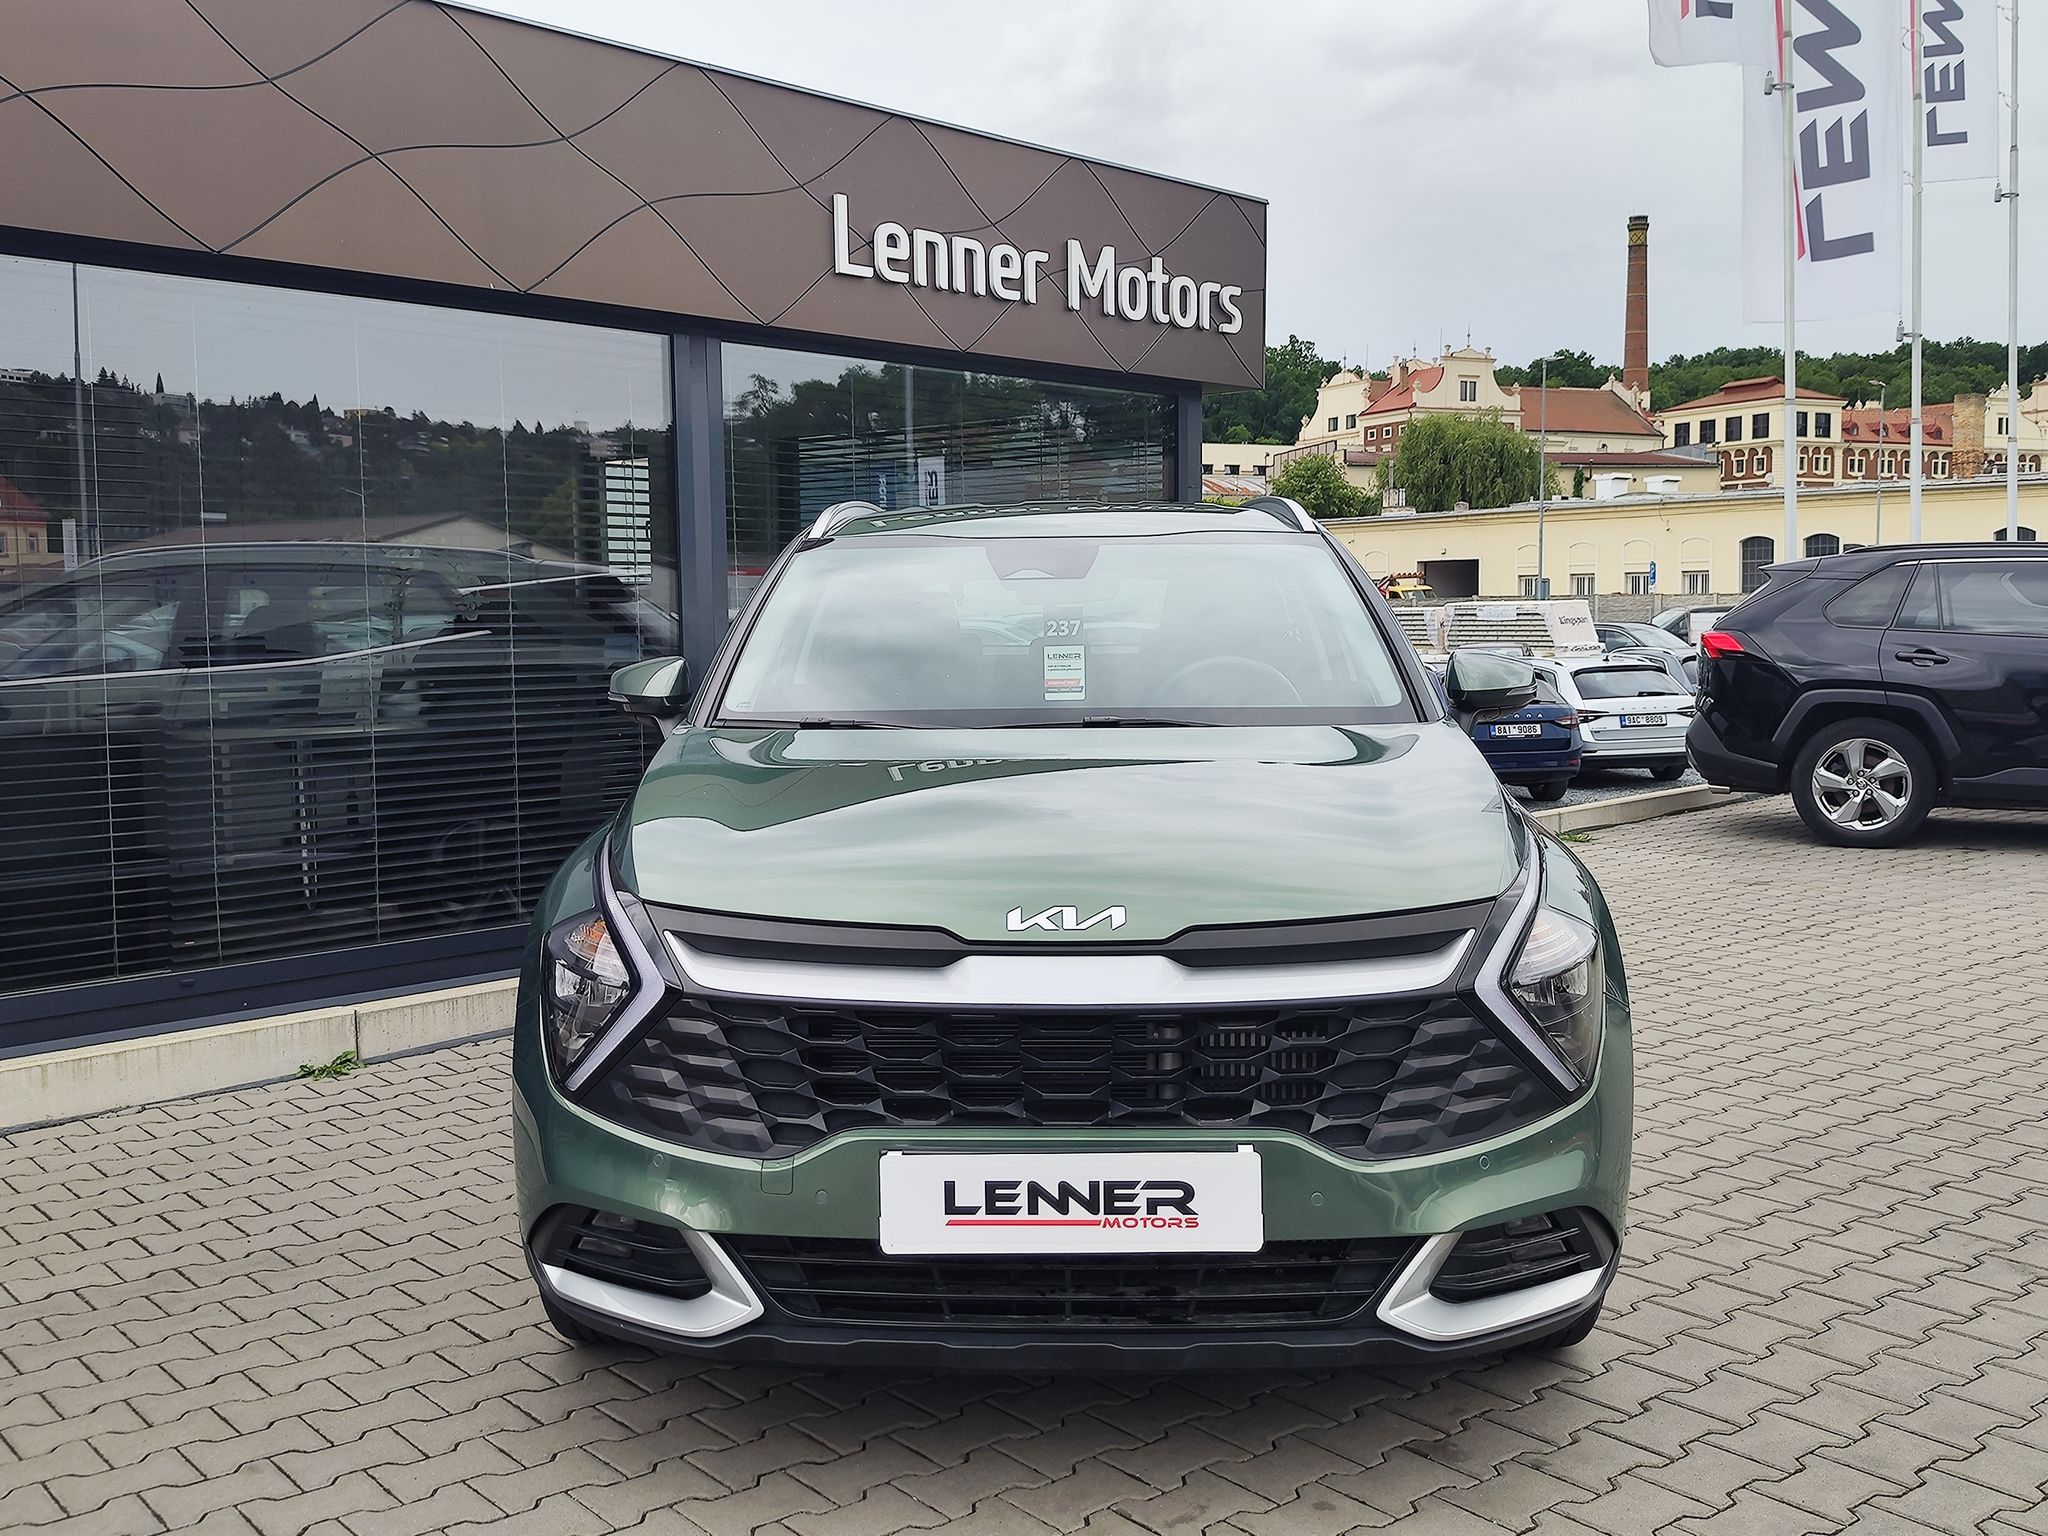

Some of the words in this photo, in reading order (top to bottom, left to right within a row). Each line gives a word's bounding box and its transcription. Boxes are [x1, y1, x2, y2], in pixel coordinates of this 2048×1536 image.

[833, 193, 1050, 305] Lenner
[1066, 238, 1244, 335] Motors
[1046, 619, 1081, 637] 237
[1518, 725, 1538, 735] 9086
[1005, 904, 1127, 932] KIA
[943, 1180, 1199, 1216] LENNER
[1102, 1216, 1199, 1229] MOTORS
